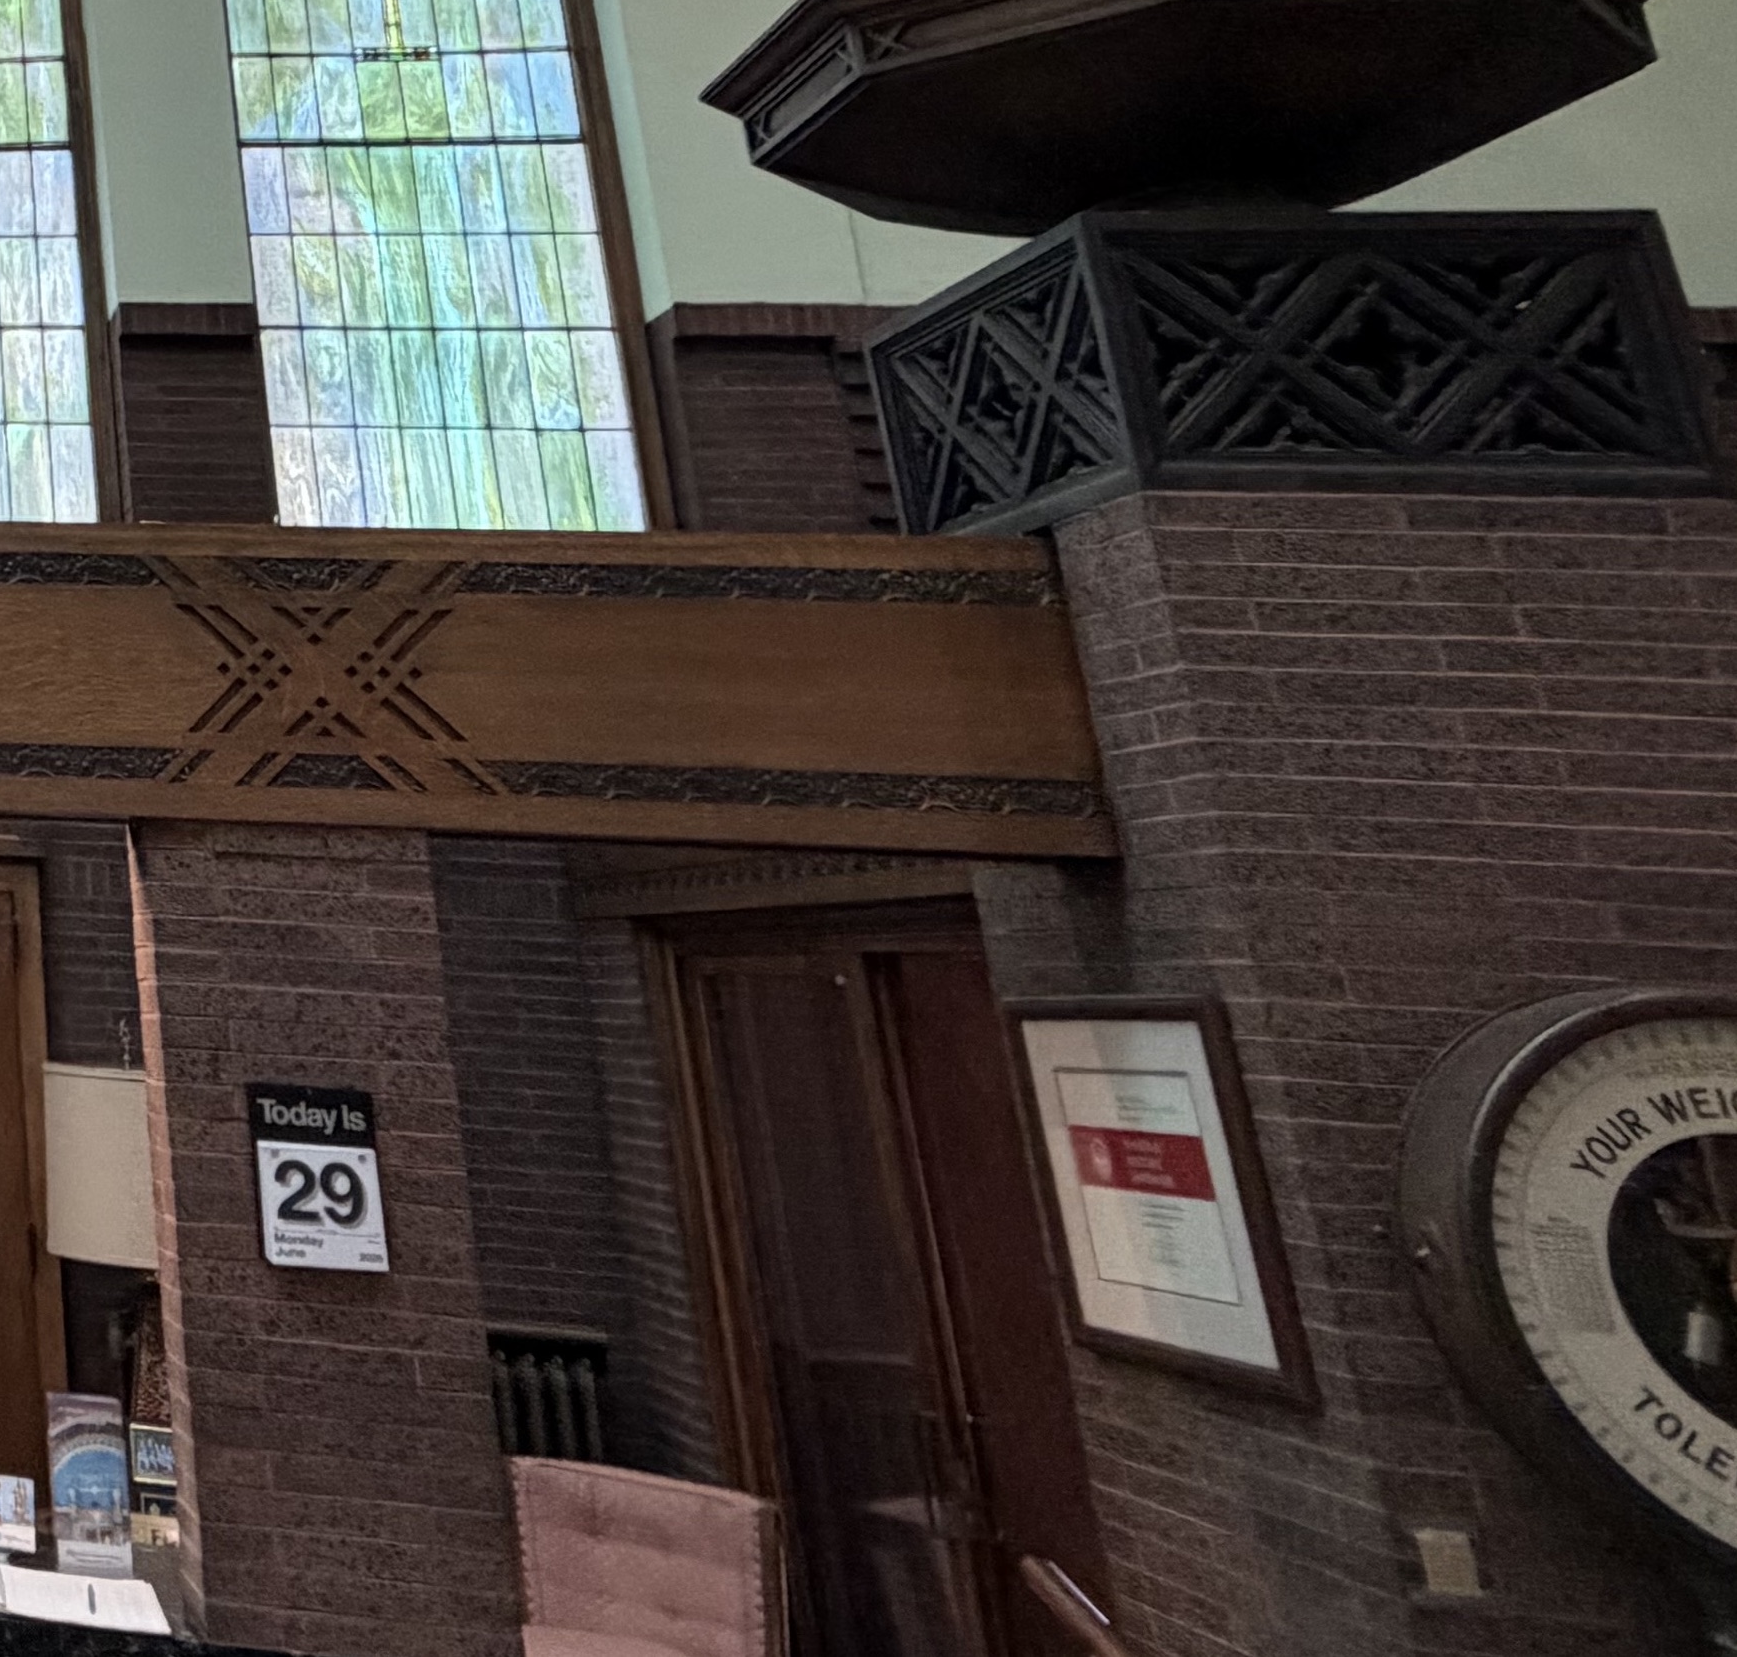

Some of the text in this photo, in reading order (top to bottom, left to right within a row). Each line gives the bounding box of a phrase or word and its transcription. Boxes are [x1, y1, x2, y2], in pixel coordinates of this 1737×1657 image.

[256, 1098, 367, 1135] Today Is
[1569, 1087, 1737, 1179] YOUR WEI
[274, 1160, 367, 1228] 29
[275, 1233, 324, 1249] Monday
[275, 1246, 307, 1259] June
[1634, 1386, 1737, 1484] TOLE
